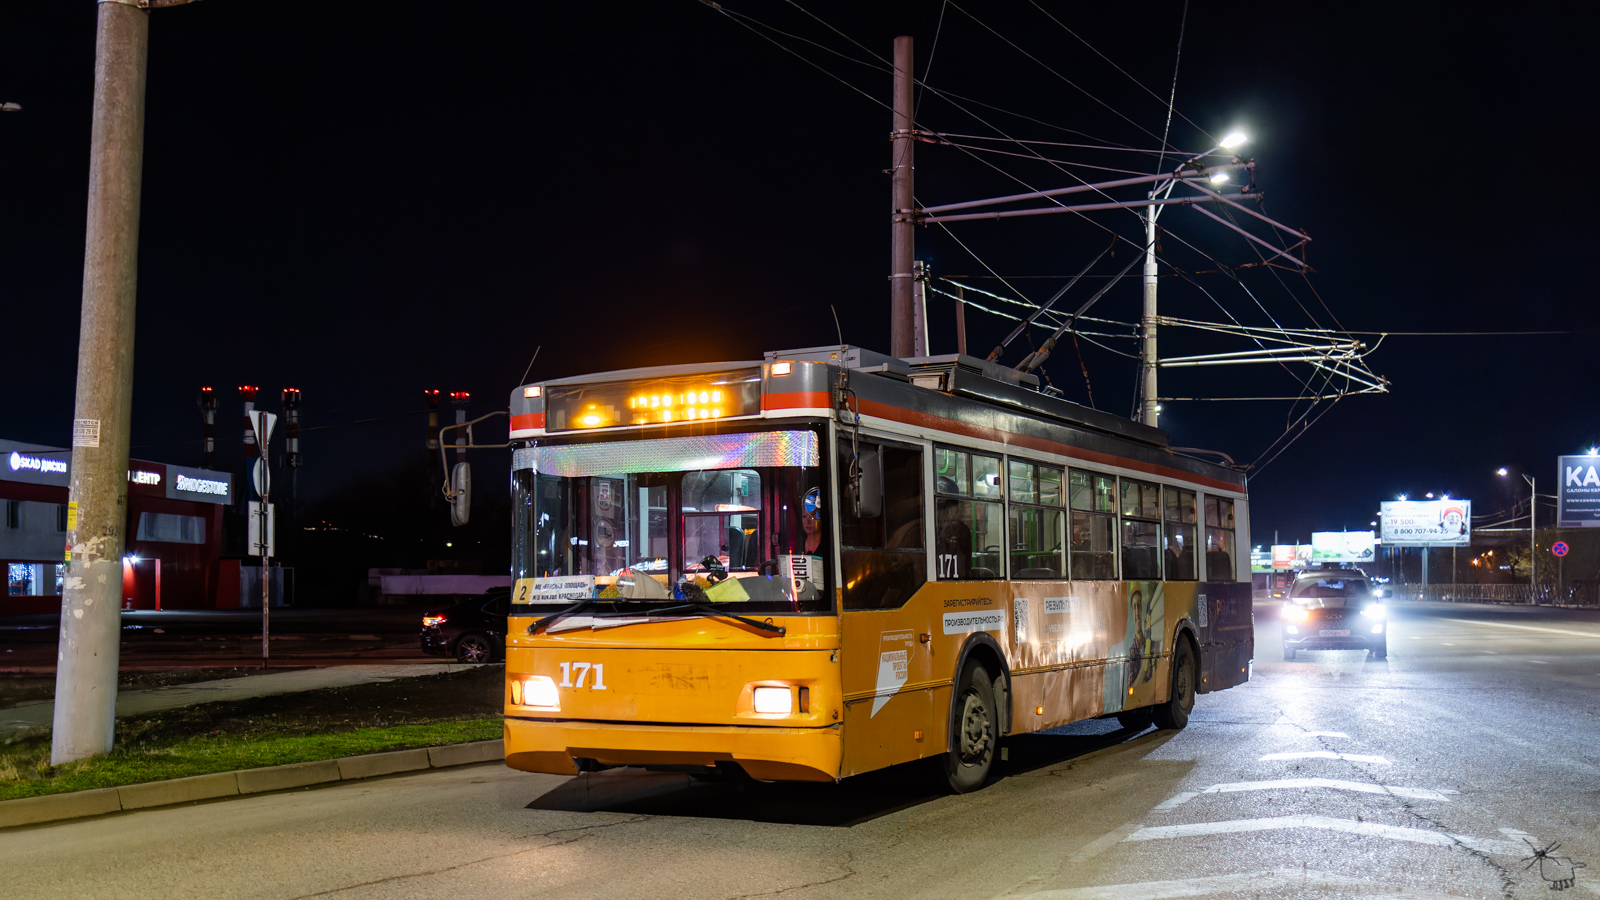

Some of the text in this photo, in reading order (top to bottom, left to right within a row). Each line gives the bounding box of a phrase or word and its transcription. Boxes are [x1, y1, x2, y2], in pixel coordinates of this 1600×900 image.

[20, 455, 67, 473] SKAD ДИСКИ
[176, 474, 228, 495] BRIDGESTONE
[938, 554, 959, 578] 171
[518, 585, 527, 601] 2
[881, 651, 907, 663] НАЦИОНАЛЬНЫЕ
[559, 662, 607, 690] 171
